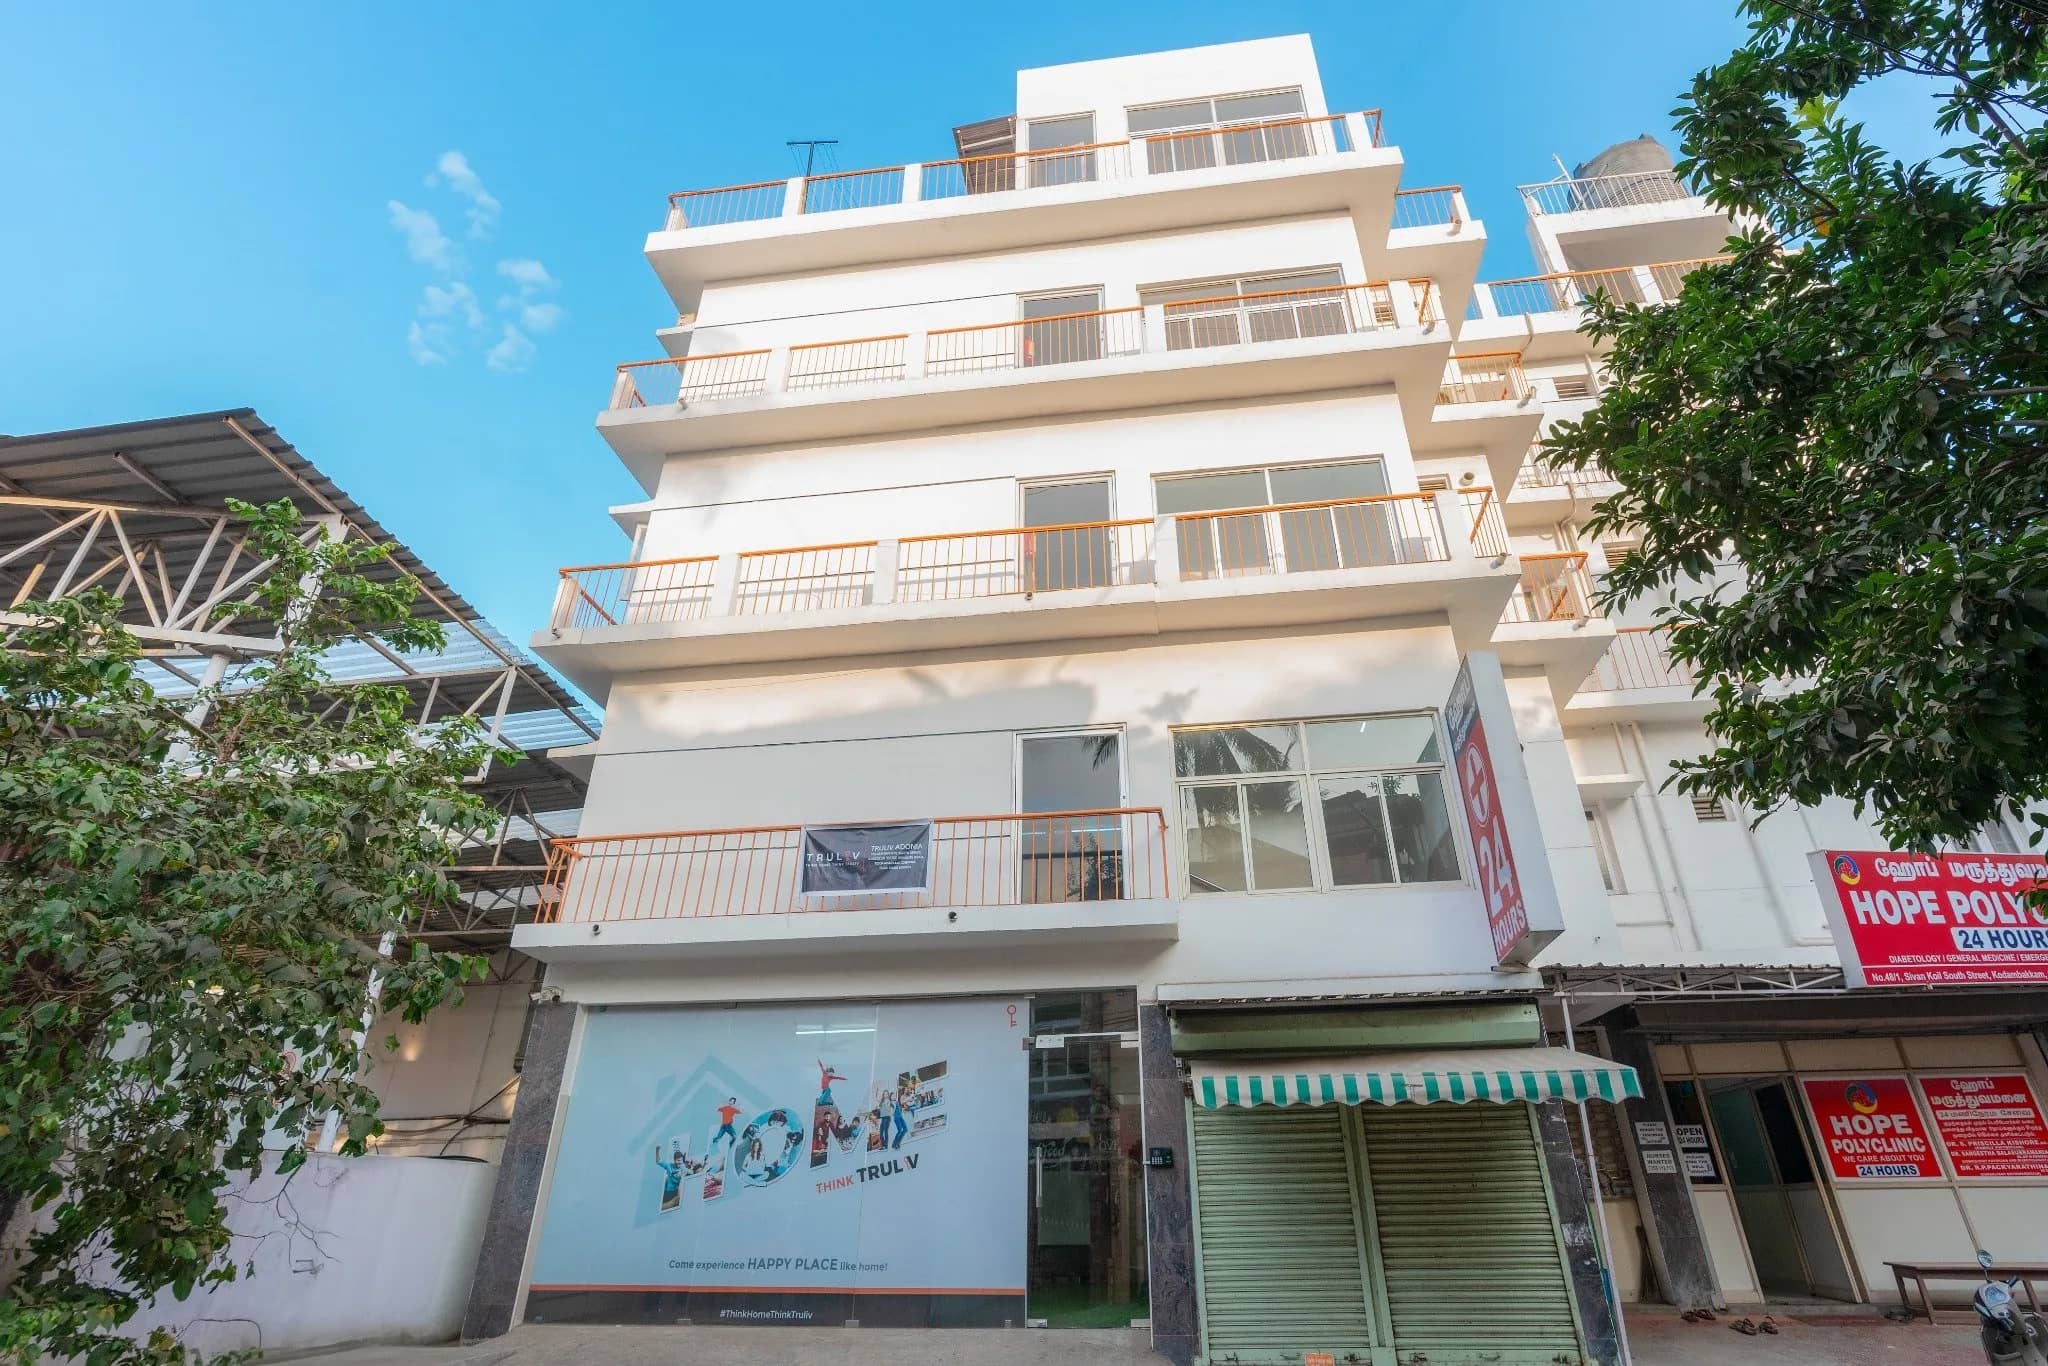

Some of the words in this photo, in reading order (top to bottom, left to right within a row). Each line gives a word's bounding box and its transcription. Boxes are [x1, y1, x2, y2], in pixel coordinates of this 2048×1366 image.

[1478, 816, 1514, 915] 24
[1875, 856, 1940, 882] ஹோப்
[1948, 857, 2048, 887] மருத்துவம
[1849, 890, 1947, 925] HOPE
[1492, 900, 1526, 948] HOURS
[1958, 929, 1984, 949] 24
[1888, 953, 1941, 964] DIABETOLOGY
[1946, 953, 1981, 963] GENERAL
[1982, 953, 2016, 963] MEDICINE
[1903, 970, 1926, 982] Sivan
[1926, 970, 1943, 982] Koil
[1943, 970, 1967, 981] South
[1967, 969, 1992, 981] Street,
[1676, 1127, 1703, 1136] OPEN
[1828, 1114, 1913, 1136] HOPE
[1830, 1137, 1927, 1154] POLYCLINIC
[1856, 1155, 1879, 1163] CARE
[1880, 1155, 1906, 1163] ABOUT
[1860, 1165, 1873, 1176] 24
[1875, 1165, 1917, 1176] HOURS
[816, 1175, 854, 1194] THINK
[668, 1259, 694, 1269] Come
[695, 1260, 745, 1272] experience
[747, 1257, 792, 1270] HAPPY
[795, 1258, 838, 1271] PLACE
[839, 1262, 857, 1271] like
[858, 1262, 888, 1271] home!
[719, 1309, 814, 1320] #ThinkHomeThinkTruliv
